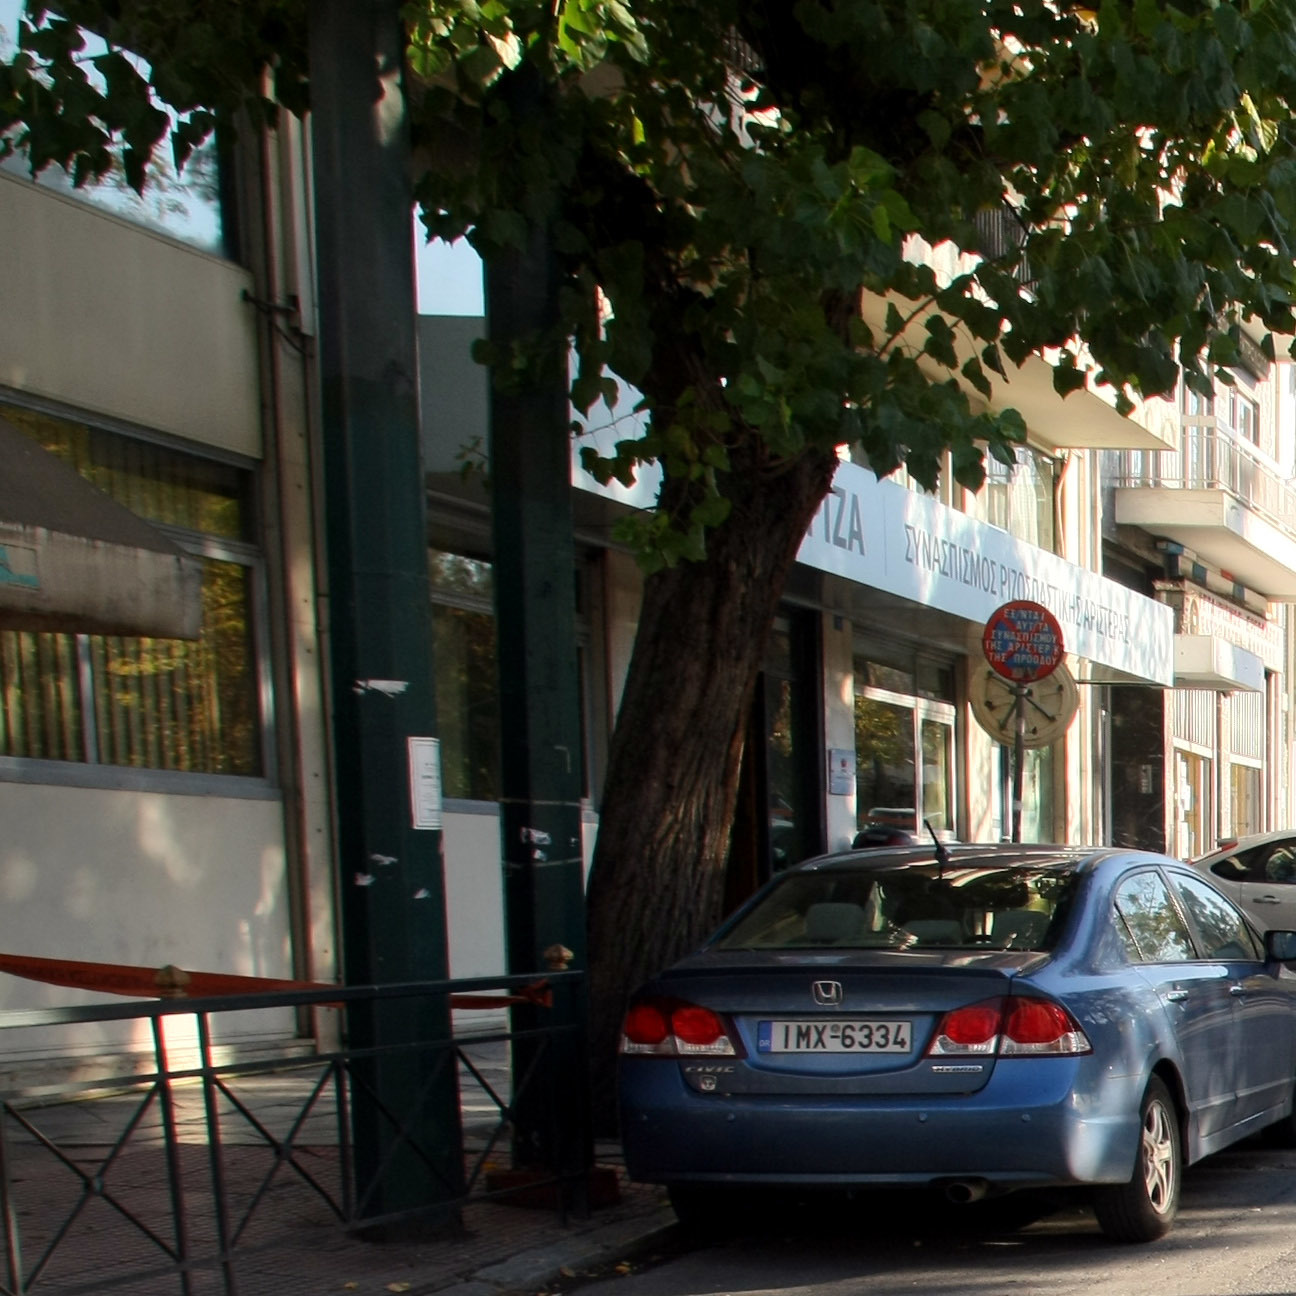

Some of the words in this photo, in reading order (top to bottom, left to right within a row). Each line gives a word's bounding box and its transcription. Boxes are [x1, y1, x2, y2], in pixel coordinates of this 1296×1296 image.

[904, 523, 997, 596] ΣΥΝΑΣΠΙΣΜΟΣ
[1083, 597, 1130, 645] ΑΡΙΣΤΕΡΑΣ
[1014, 654, 1056, 665] ΠΡΟΟΔΟΥ
